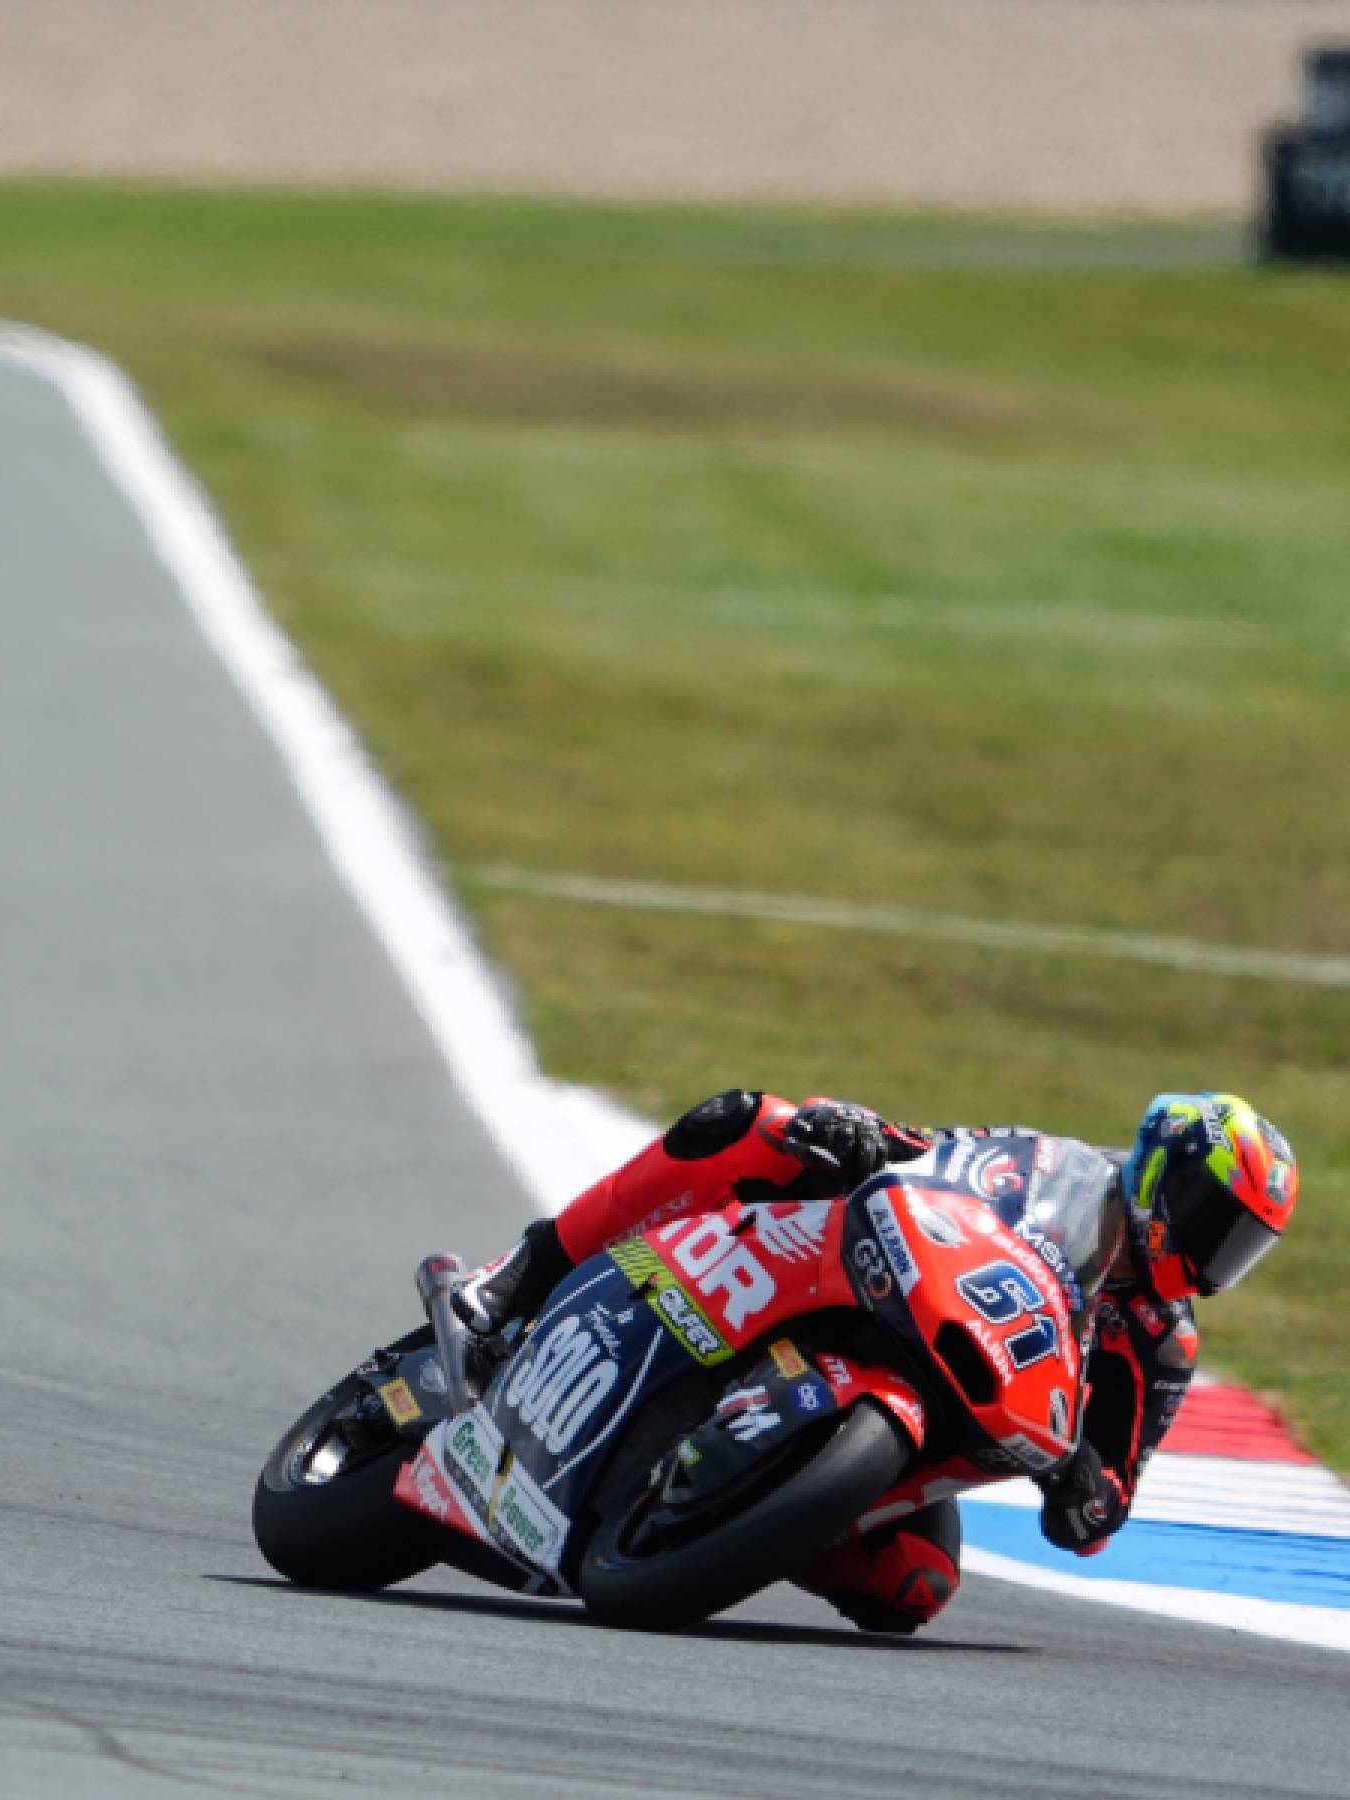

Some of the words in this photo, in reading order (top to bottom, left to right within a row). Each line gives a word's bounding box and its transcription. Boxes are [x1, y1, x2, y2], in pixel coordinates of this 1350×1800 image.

[954, 1260, 1061, 1370] 61
[507, 1315, 620, 1455] SOLO
[450, 1420, 494, 1482] Green
[500, 1485, 545, 1553] Power
